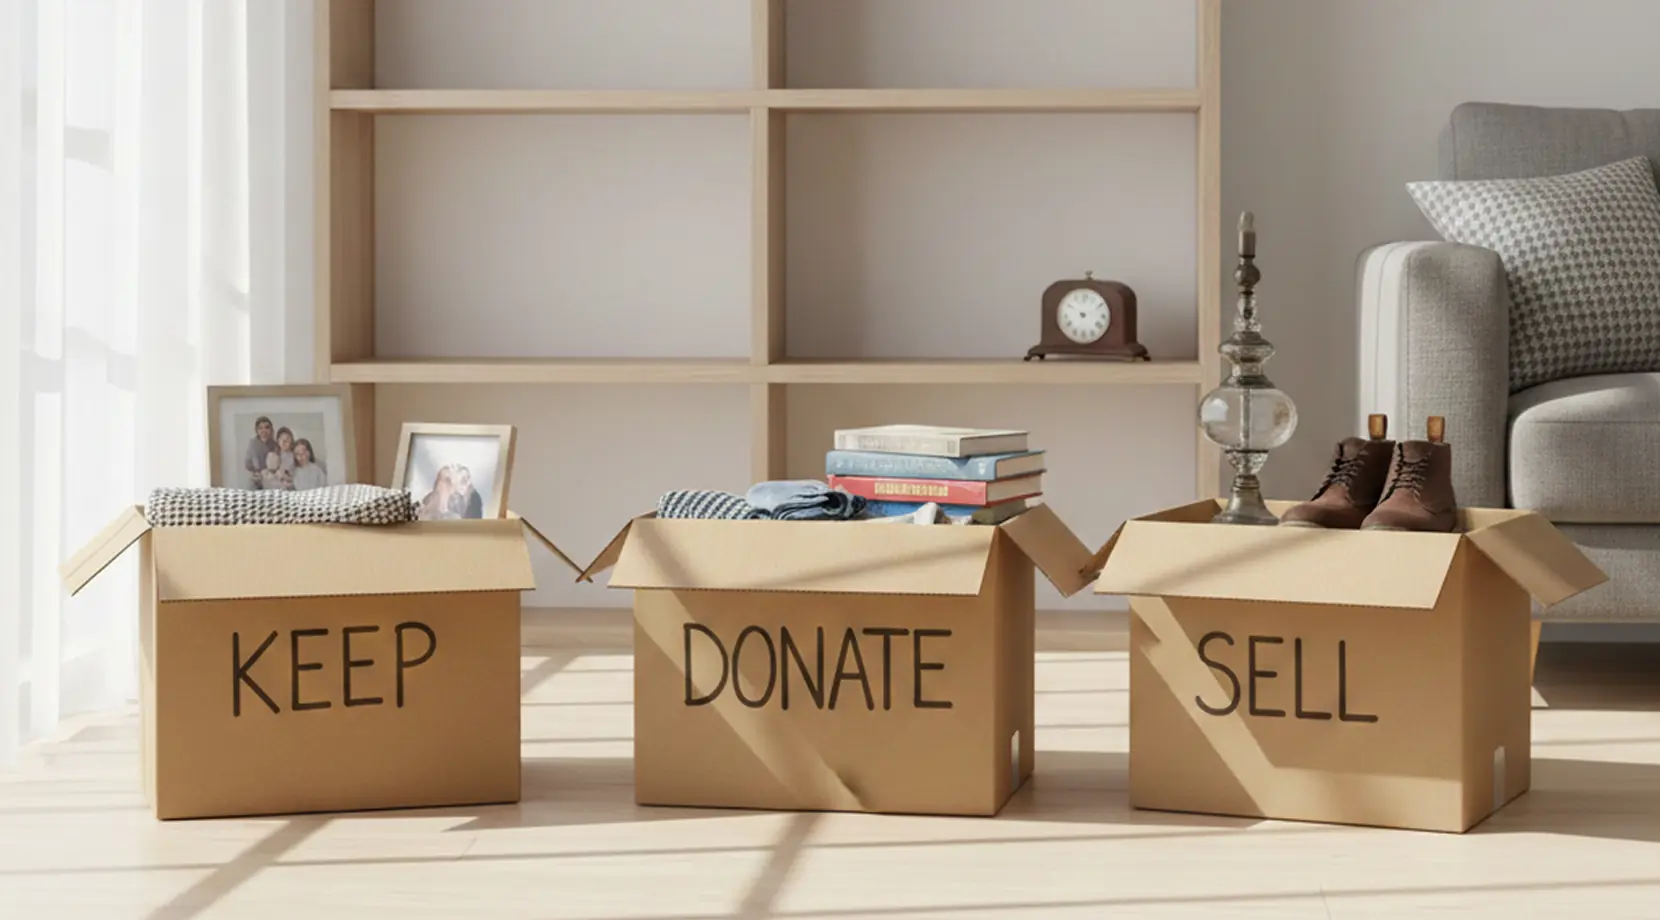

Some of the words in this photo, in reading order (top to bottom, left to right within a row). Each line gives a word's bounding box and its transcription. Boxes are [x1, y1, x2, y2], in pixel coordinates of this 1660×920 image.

[232, 620, 437, 718] KEEP
[683, 622, 954, 711] DONATE
[1195, 630, 1380, 724] SELL
